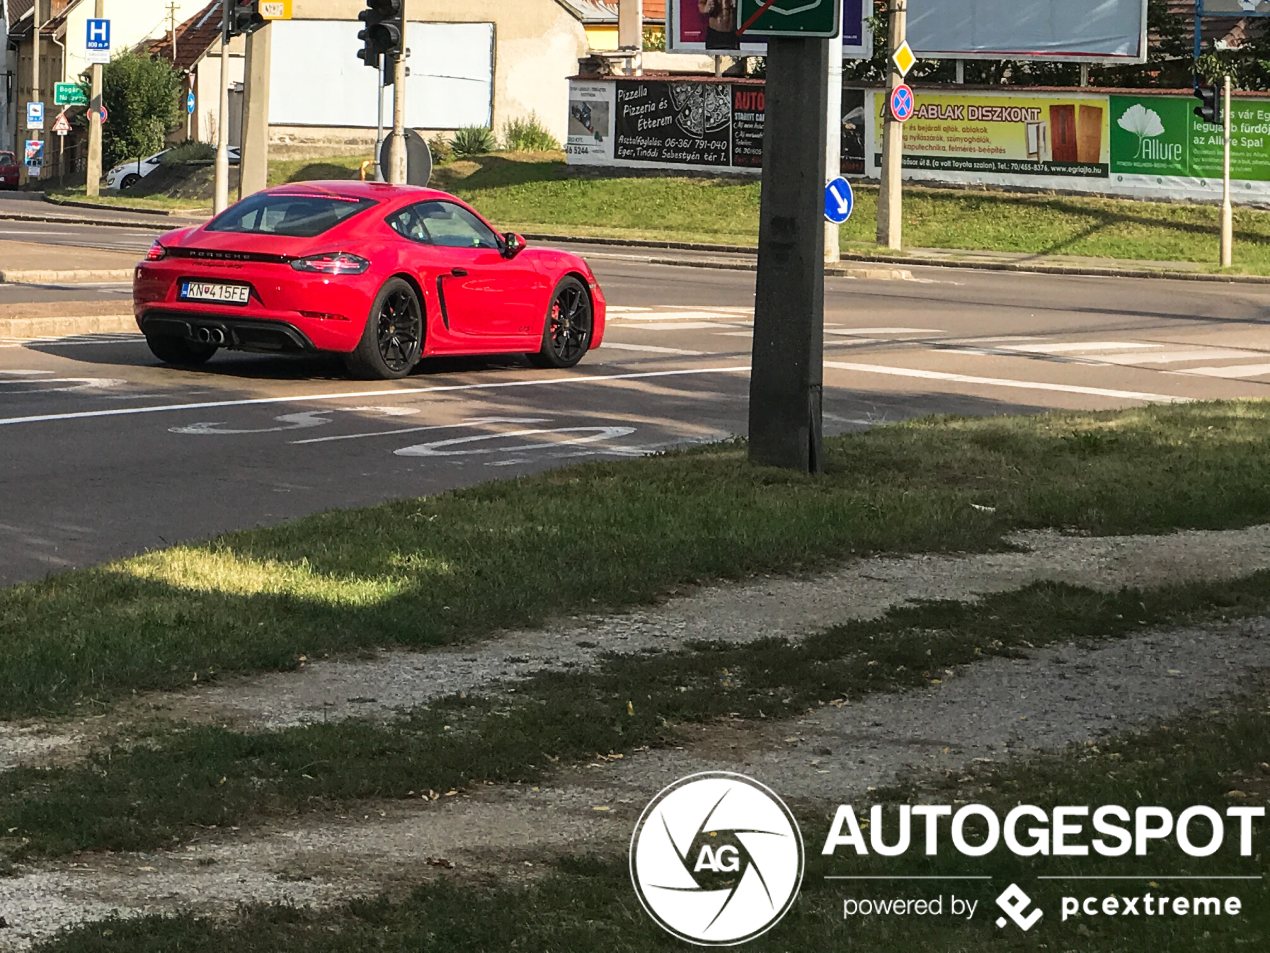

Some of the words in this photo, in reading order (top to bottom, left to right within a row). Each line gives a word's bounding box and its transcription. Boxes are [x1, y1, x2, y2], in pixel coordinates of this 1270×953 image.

[90, 21, 107, 41] H
[618, 84, 648, 102] Pizzella
[623, 100, 656, 117] Pizzeria
[658, 97, 668, 110] és
[967, 106, 1042, 122] DISZKONT
[1237, 109, 1255, 120] vár
[637, 114, 673, 132] Étterem
[618, 135, 663, 148] Asztalfoglalás:
[694, 139, 728, 151] 791-040
[1142, 138, 1182, 161] Allure
[1193, 135, 1206, 145] az
[1240, 137, 1264, 149] Spa!
[661, 148, 701, 162] Sebestyén
[703, 152, 717, 162] tér
[720, 152, 727, 162] 1.
[952, 160, 972, 169] Toyota
[190, 250, 250, 260] PORSCHE
[189, 283, 204, 296] KN
[210, 285, 247, 300] 415FE
